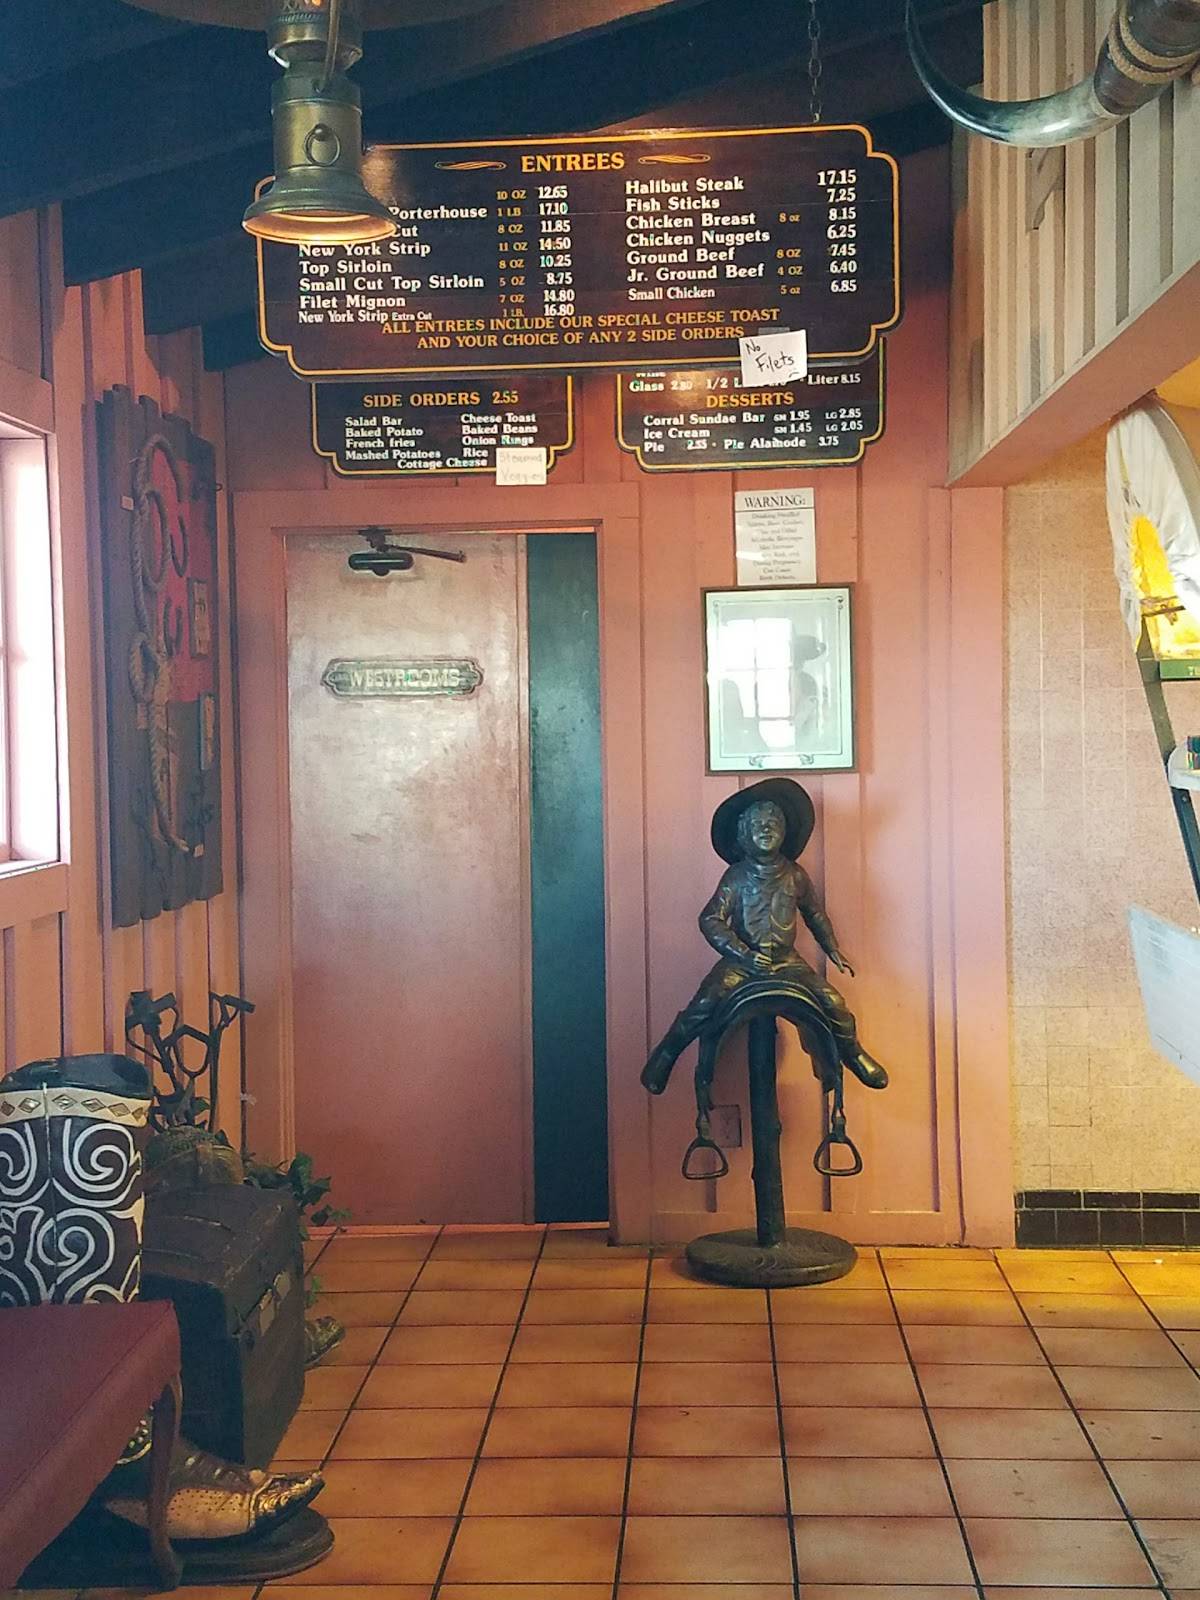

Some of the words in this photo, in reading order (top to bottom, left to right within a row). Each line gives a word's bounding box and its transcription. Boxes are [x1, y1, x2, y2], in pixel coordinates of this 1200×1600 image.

[521, 151, 625, 173] ENTREES
[626, 180, 688, 194] Halibut
[696, 177, 744, 192] Steak
[817, 170, 857, 186] 17.15
[496, 191, 508, 200] 10
[511, 190, 526, 199] OZ
[538, 186, 568, 198] 12.65
[626, 198, 660, 212] Fish
[668, 196, 720, 210] Sticks
[826, 188, 856, 202] 7.25
[389, 205, 487, 220] Porterhouse
[497, 208, 502, 216] 1
[539, 202, 568, 215] 17.10
[626, 215, 693, 230] Chicken
[702, 212, 756, 226] Breast
[779, 213, 786, 222] 8
[829, 207, 856, 221] 8.15
[498, 225, 505, 233] 8
[508, 224, 523, 233] OZ
[541, 220, 571, 233] 11.85
[626, 233, 693, 247] Chicken
[702, 230, 770, 246] Nuggets
[827, 225, 856, 239] 6.25
[298, 245, 335, 257] New
[343, 244, 380, 256] York
[389, 242, 431, 258] Strip
[499, 242, 509, 251] 11
[513, 242, 528, 251] OZ
[539, 237, 571, 250] 14.50
[626, 250, 688, 265] Ground
[696, 247, 735, 262] Beef
[776, 250, 784, 258] 8
[830, 244, 856, 256] 7.45
[299, 260, 329, 277] Top
[337, 260, 392, 274] Sirloin
[499, 260, 506, 269] 8
[510, 259, 524, 268] OZ
[540, 254, 572, 267] 10.25
[626, 269, 648, 283] Jr.
[656, 267, 717, 281] Ground
[726, 263, 765, 279] Beef
[777, 267, 784, 275] 4
[830, 260, 857, 273] 6.40
[299, 277, 346, 292] Small
[354, 276, 384, 291] Cut
[391, 275, 421, 293] Top
[429, 275, 484, 289] Sirloin
[499, 278, 505, 286] 5
[511, 277, 525, 285] OZ
[546, 272, 572, 285] 8.75
[628, 288, 663, 301] Small
[667, 287, 715, 299] Chicken
[780, 286, 786, 294] 5
[831, 280, 857, 293] 6.85
[300, 295, 340, 309] Filet
[346, 294, 405, 311] Mignon
[510, 295, 524, 303] OZ
[544, 289, 575, 302] 14.80
[298, 311, 324, 323] New
[328, 310, 358, 322] York
[360, 309, 387, 324] Strip
[544, 304, 574, 316] 16.80
[382, 321, 410, 334] ALL
[416, 319, 485, 333] ENTREES
[490, 318, 554, 331] INCLUDE
[560, 316, 592, 328] OUR
[597, 313, 660, 328] SPECIAL
[666, 311, 724, 325] CHEESE
[730, 308, 780, 322] TOAST
[417, 336, 451, 349] AND
[456, 335, 498, 348] YOUR
[503, 333, 558, 346] CHOICE
[564, 332, 584, 345] OF
[589, 330, 621, 343] ANY
[626, 330, 636, 342] 2
[641, 329, 676, 342] SIDE
[681, 327, 745, 340] ORDERS
[745, 339, 761, 355] No
[755, 351, 794, 373] Filets
[629, 380, 664, 392] Glass
[706, 377, 728, 389] 1/2
[807, 375, 838, 385] Liter
[842, 373, 861, 383] 8.15
[363, 394, 402, 408] SIDE
[410, 391, 480, 406] ORDERS
[492, 390, 519, 404] 2.55
[706, 392, 795, 409] DESSERTS
[345, 417, 377, 426] Salad
[382, 417, 402, 425] Bar
[461, 414, 502, 423] Cheese
[505, 413, 535, 422] Toast
[644, 415, 684, 426] Corral
[689, 415, 736, 424] Sundae
[743, 413, 765, 423] Bar
[790, 411, 810, 421] 1.95
[839, 408, 862, 419] 2.85
[346, 427, 381, 437] Baked
[387, 427, 423, 436] Potato
[462, 425, 498, 435] Baked
[503, 424, 538, 434] Beans
[644, 429, 663, 439] Ice
[668, 428, 710, 438] Cream
[791, 423, 812, 433] 1.45
[841, 421, 863, 431] 2.05
[346, 439, 384, 448] French
[462, 436, 496, 445] Onion
[501, 436, 534, 447] Rings
[644, 442, 665, 453] Pie
[724, 439, 744, 449] Pie
[818, 436, 839, 447] 3.75
[346, 450, 389, 460] Mashed
[392, 449, 441, 459] Potatoes
[463, 448, 488, 458] Rice
[397, 460, 442, 470] Cottage
[446, 458, 488, 468] Cheese
